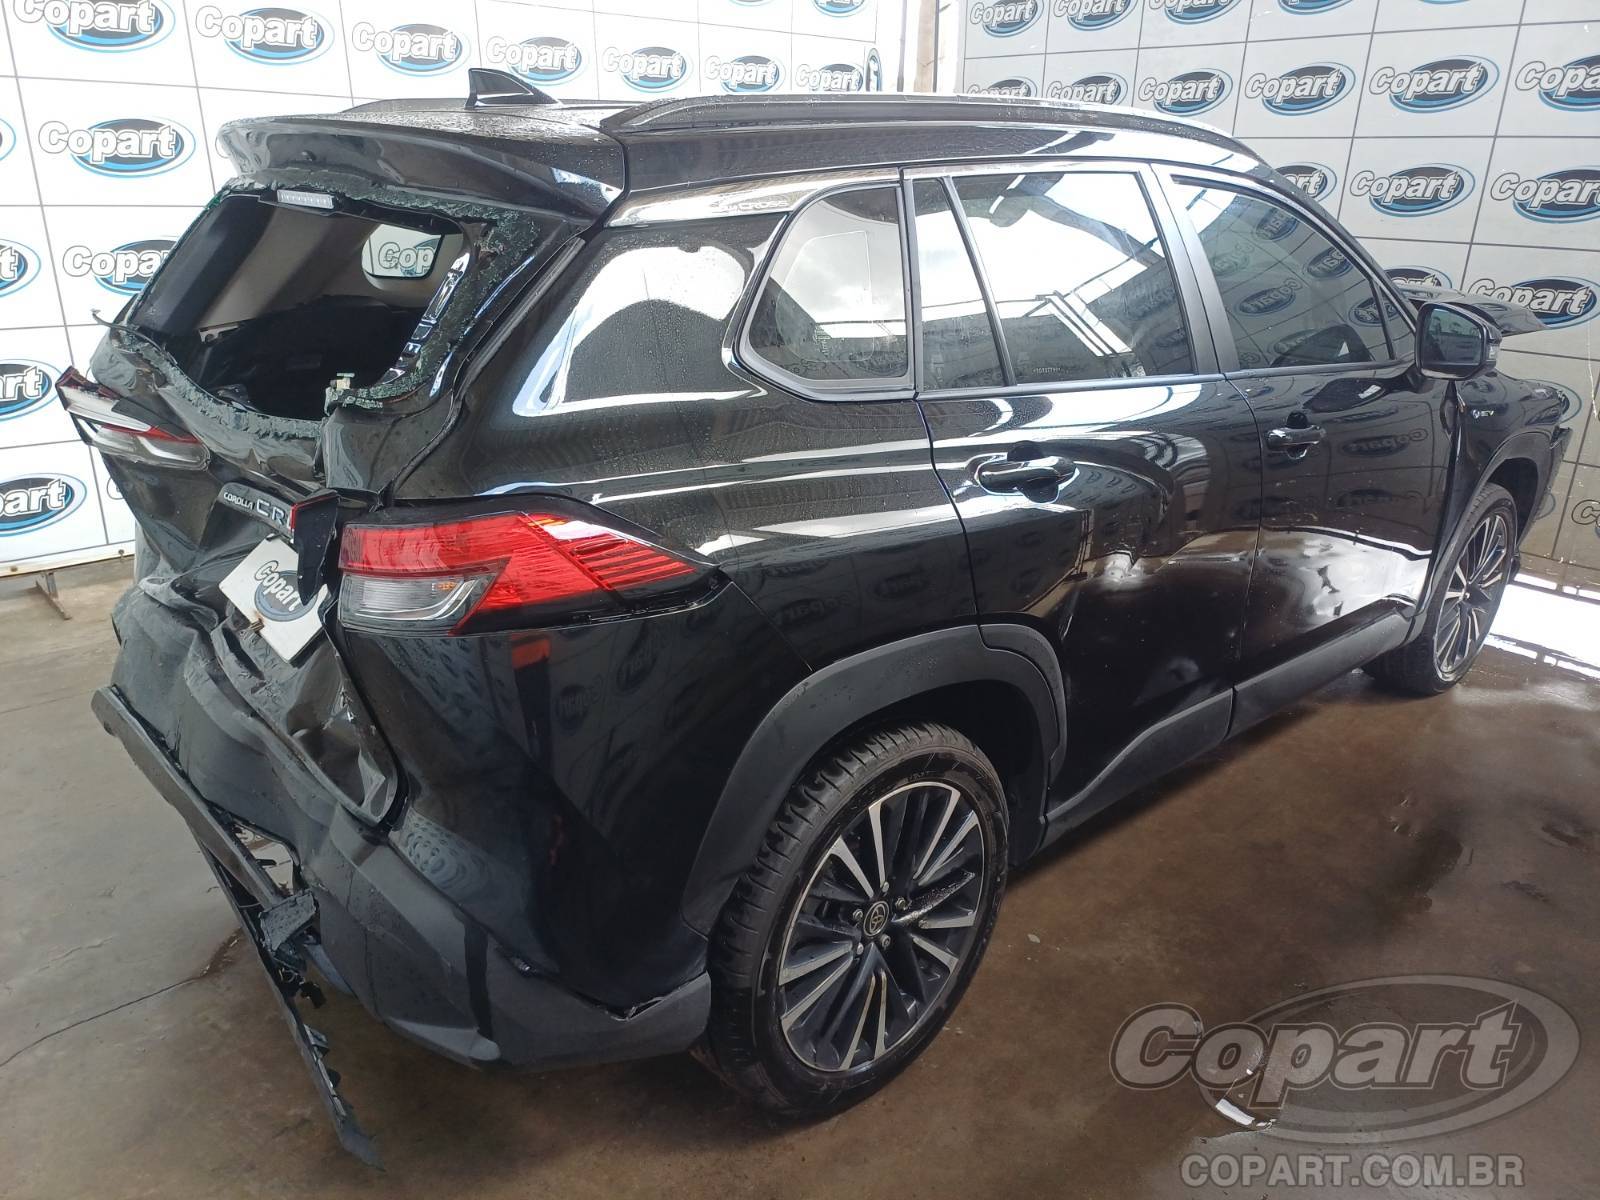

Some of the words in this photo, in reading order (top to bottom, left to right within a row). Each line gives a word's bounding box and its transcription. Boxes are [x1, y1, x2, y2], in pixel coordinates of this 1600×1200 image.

[14, 0, 155, 35] Copart
[196, 5, 317, 49] Copart
[970, 0, 1035, 28] Copart
[352, 22, 457, 61] Copart
[486, 35, 577, 72] Copart
[602, 46, 684, 78] Copart
[703, 55, 776, 85] Copart
[795, 63, 860, 91] Copart
[1515, 61, 1600, 98] Copa
[1138, 74, 1221, 107] Copart
[1245, 69, 1344, 105] Copart
[1369, 63, 1484, 103] Copart
[38, 121, 176, 163] Copart
[1350, 171, 1459, 205] Copart
[1491, 172, 1600, 209] Copar
[62, 246, 166, 284] Copa
[256, 498, 292, 531] CR
